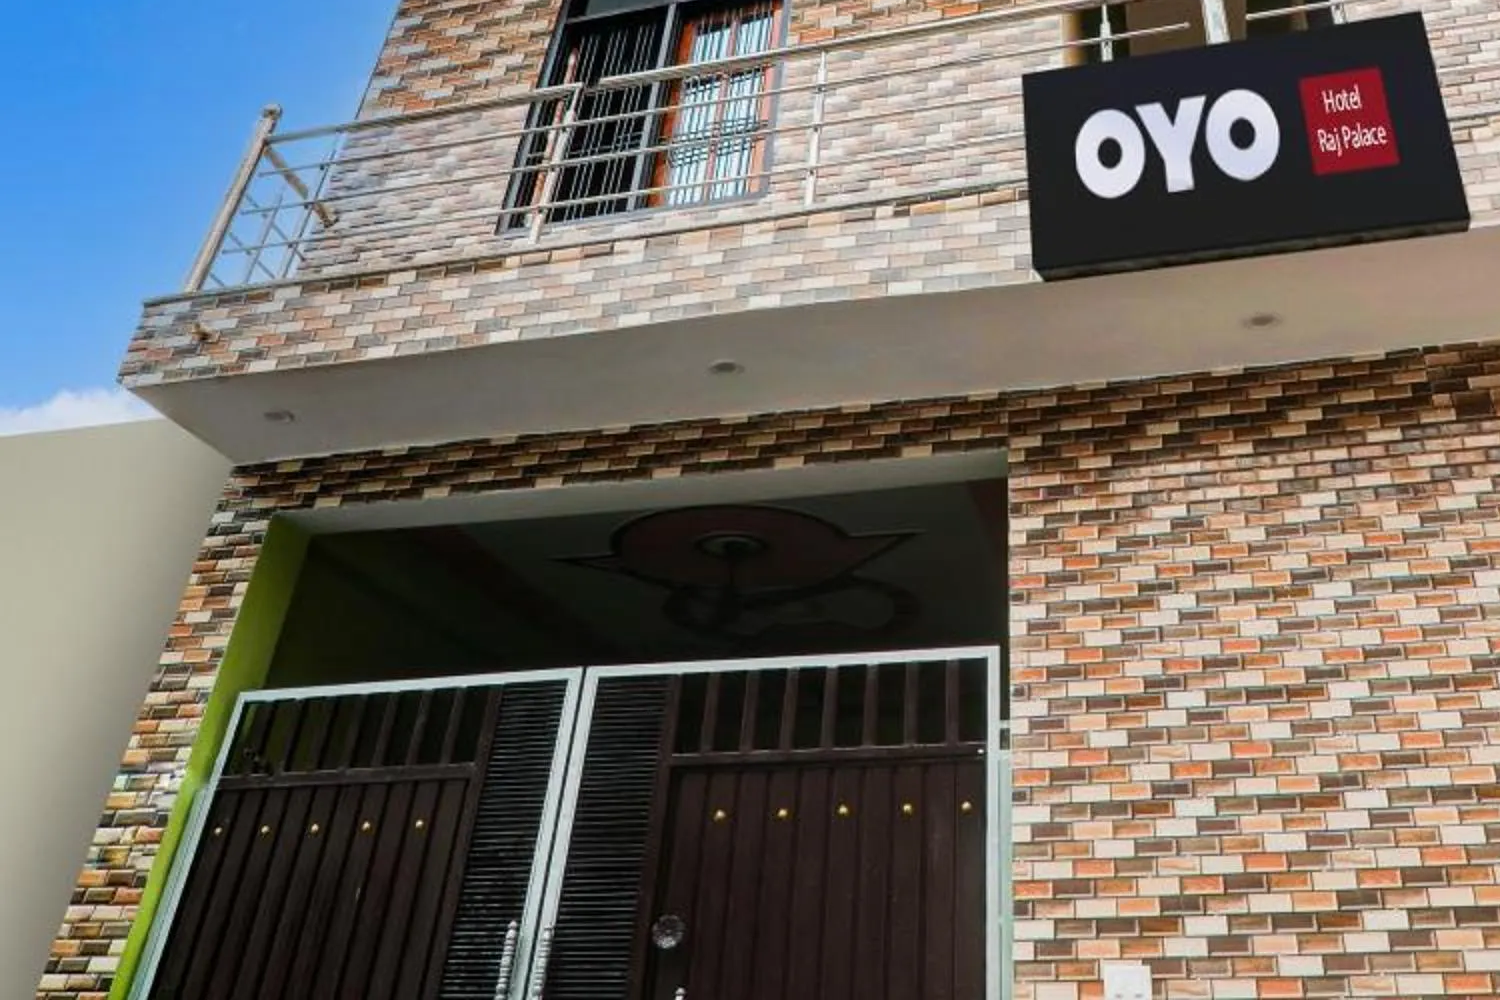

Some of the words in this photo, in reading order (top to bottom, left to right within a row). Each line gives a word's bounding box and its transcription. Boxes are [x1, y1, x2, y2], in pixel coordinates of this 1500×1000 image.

[1322, 84, 1363, 113] Hotel
[1075, 88, 1281, 199] OYO
[1317, 128, 1342, 157] Raj
[1341, 124, 1388, 150] Palace
